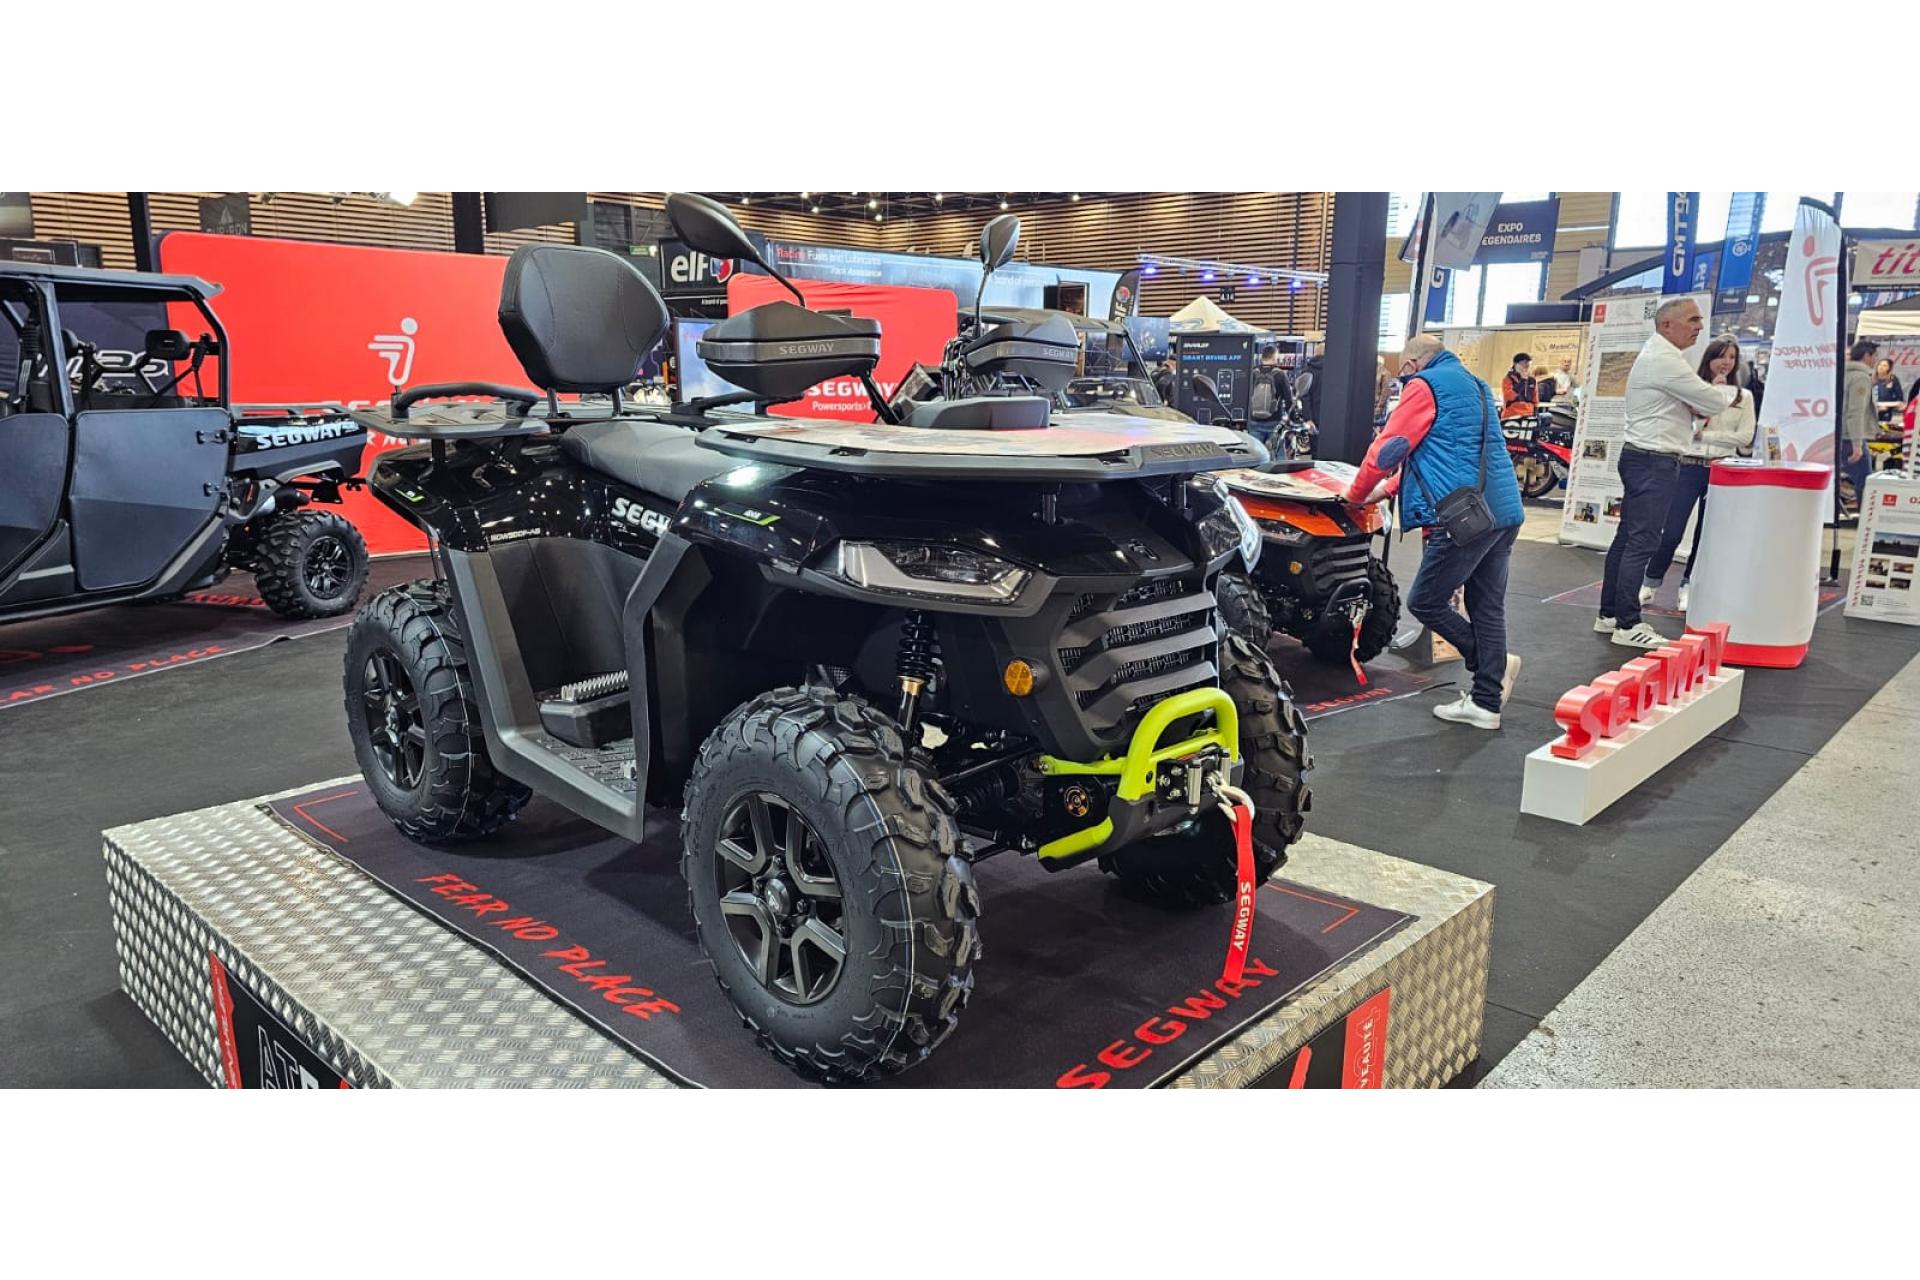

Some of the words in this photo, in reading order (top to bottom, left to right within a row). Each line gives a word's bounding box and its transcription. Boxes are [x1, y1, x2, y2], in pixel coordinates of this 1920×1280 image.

[1481, 233, 1542, 246] EGENDAIRES
[1498, 222, 1523, 233] EXPO
[671, 251, 709, 282] elf
[1872, 243, 1920, 275] tit
[779, 343, 835, 355] SEGWAY
[256, 421, 344, 450] SEGWAY
[71, 670, 115, 686] NO
[128, 645, 225, 672] PLACE
[1550, 622, 1731, 760] SEGWAY
[1232, 881, 1251, 951] SEGWAY
[413, 873, 510, 918] FEAR
[483, 915, 559, 941] NO
[536, 943, 682, 1022] PLACE
[1055, 957, 1280, 1089] SEGWAY
